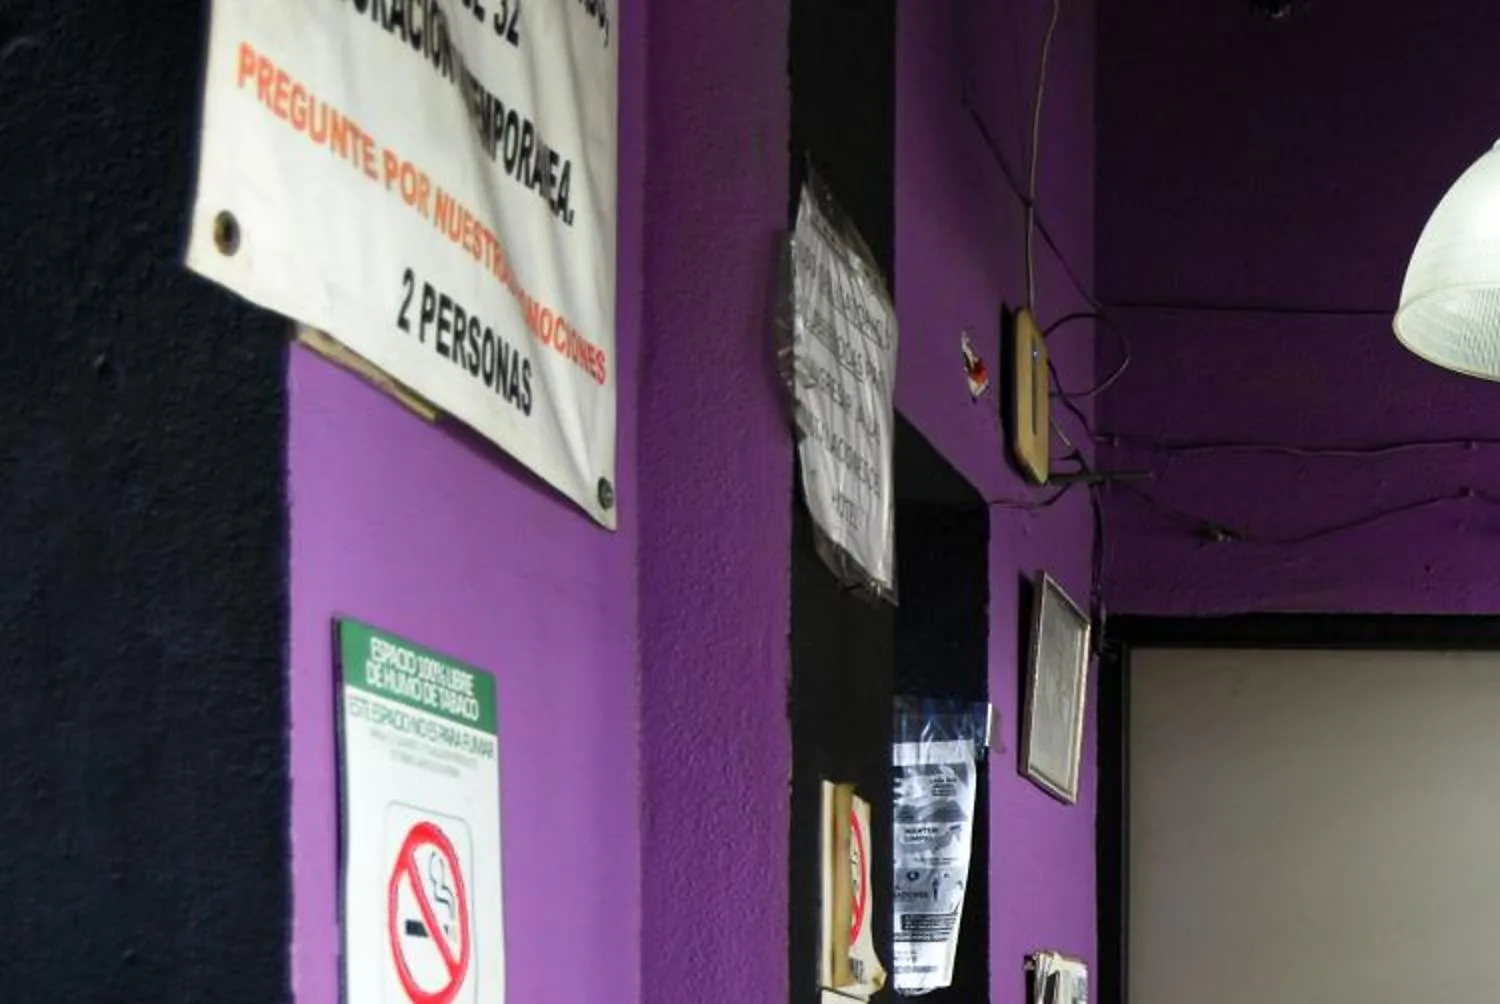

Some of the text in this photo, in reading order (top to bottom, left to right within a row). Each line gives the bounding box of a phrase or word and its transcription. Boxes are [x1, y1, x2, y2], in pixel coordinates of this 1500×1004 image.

[236, 42, 379, 181] PREGUNTE
[384, 149, 431, 220] POR
[397, 267, 533, 417] 2 PERSONAS
[370, 636, 418, 675] ESPACIO
[384, 667, 422, 701] HUMO
